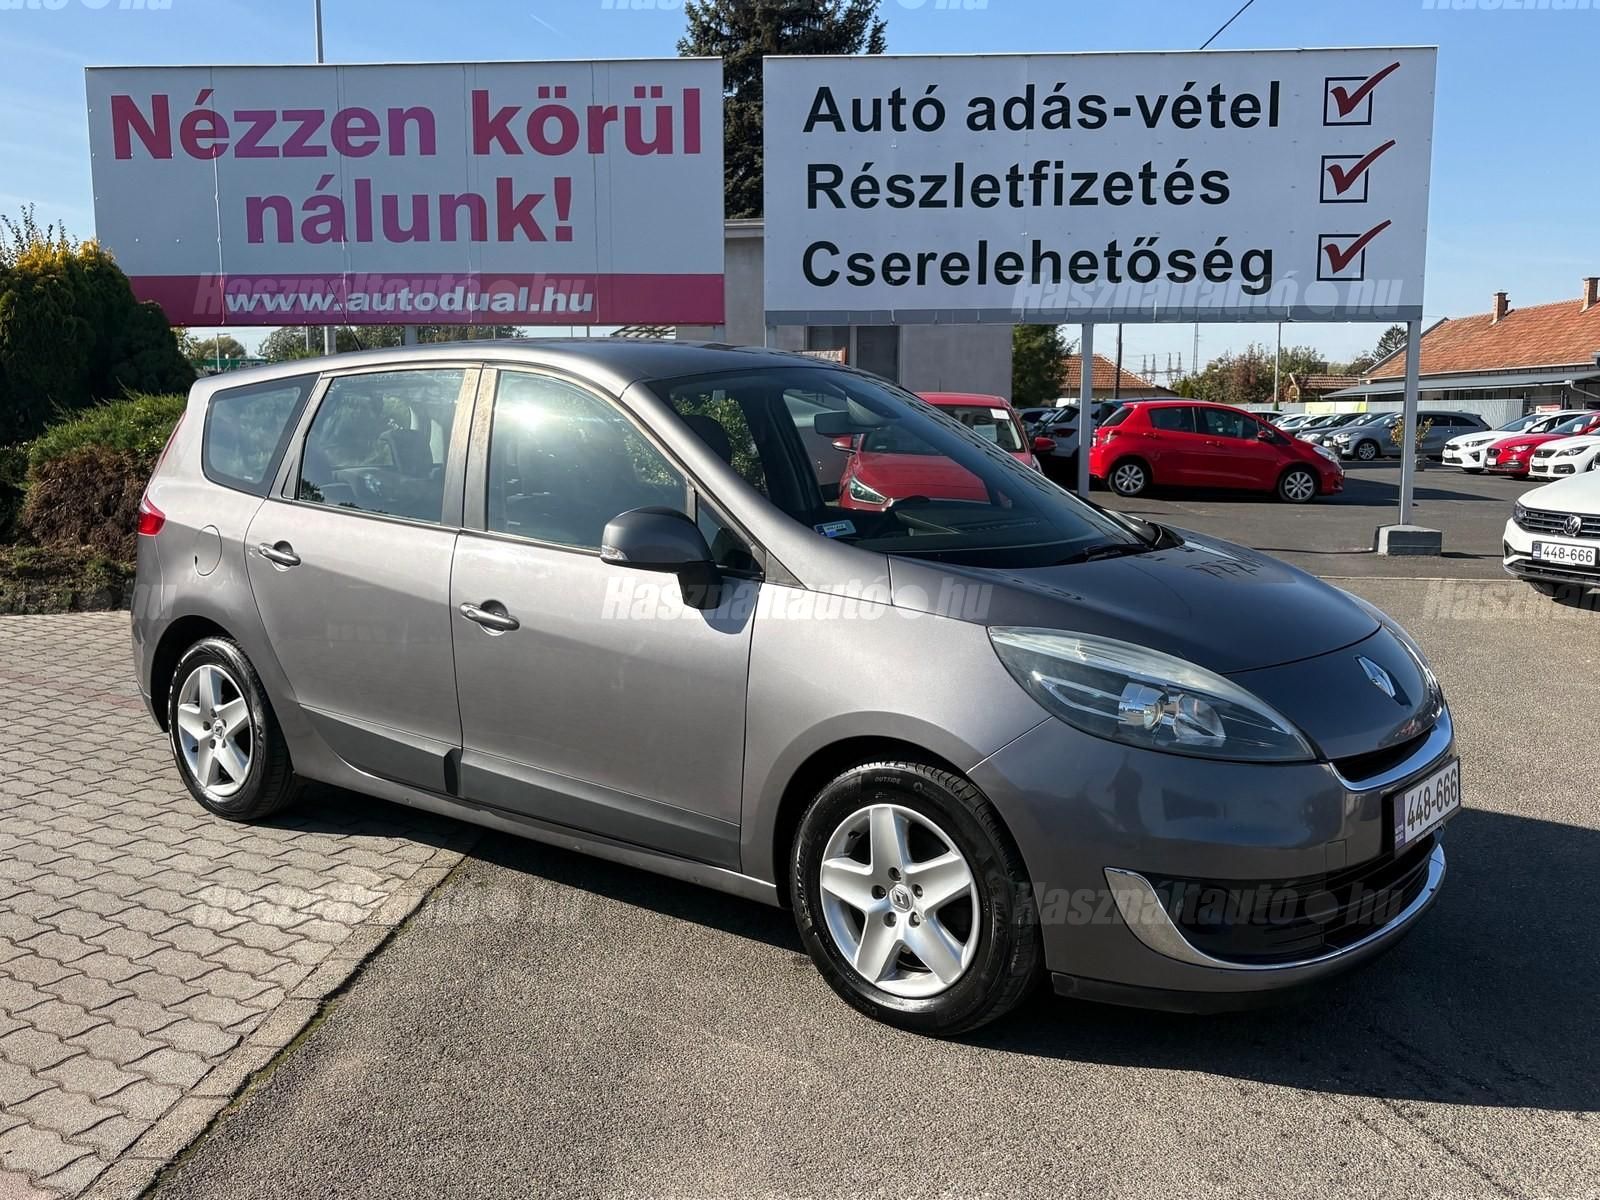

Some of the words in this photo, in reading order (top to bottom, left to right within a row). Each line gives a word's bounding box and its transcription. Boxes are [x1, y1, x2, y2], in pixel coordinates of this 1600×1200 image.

[112, 89, 435, 159] Nézzen
[473, 86, 700, 155] körül
[803, 84, 945, 133] Autó
[967, 81, 1280, 131] adás-vétel
[247, 175, 573, 243] nálunk!
[807, 158, 1230, 209] Részletfizetés
[802, 236, 1273, 296] Cserelehetőség
[224, 286, 593, 313] www.autodual.hu
[1543, 545, 1593, 563] 448-666
[1407, 767, 1458, 832] 448-666
